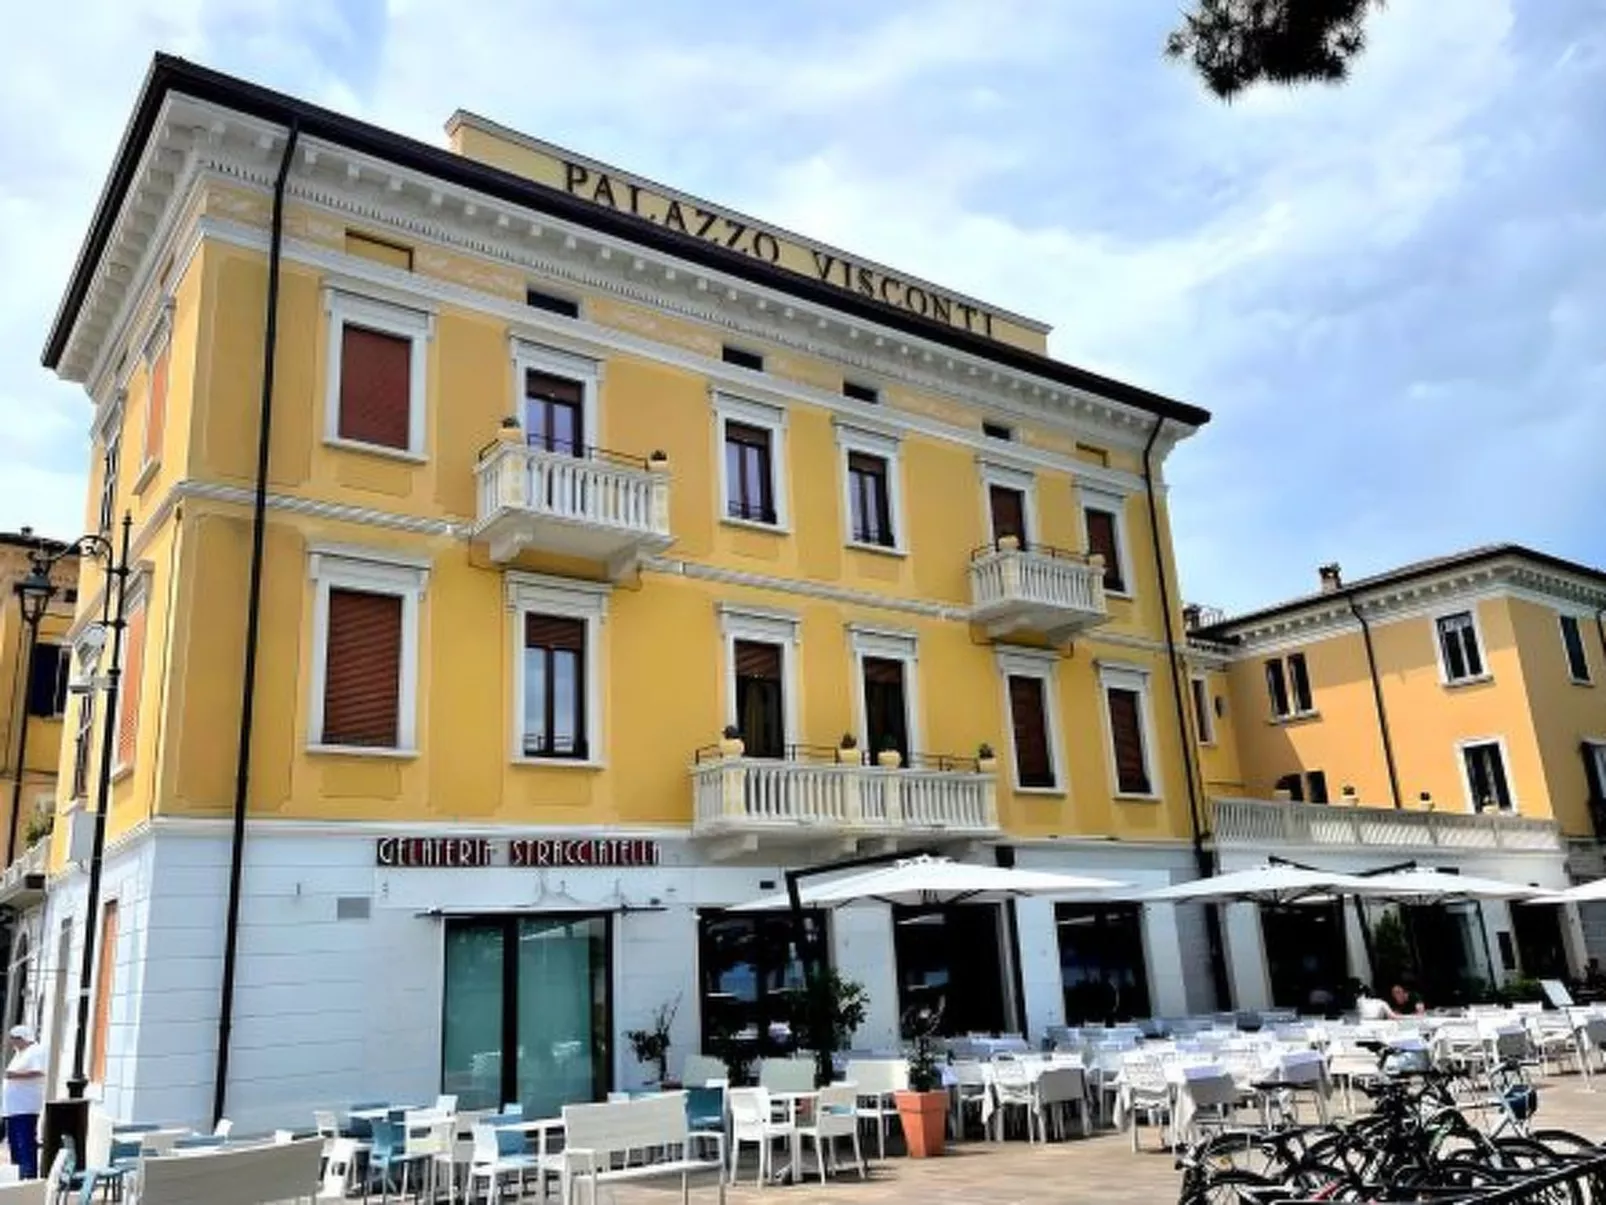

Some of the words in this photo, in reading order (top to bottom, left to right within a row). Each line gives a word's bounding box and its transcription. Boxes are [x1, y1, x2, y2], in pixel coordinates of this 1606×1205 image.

[563, 162, 780, 264] PALAZZO
[812, 251, 995, 337] VISCONTI
[378, 838, 493, 866] GELATERIA
[511, 840, 662, 866] STRACCIATELLA
